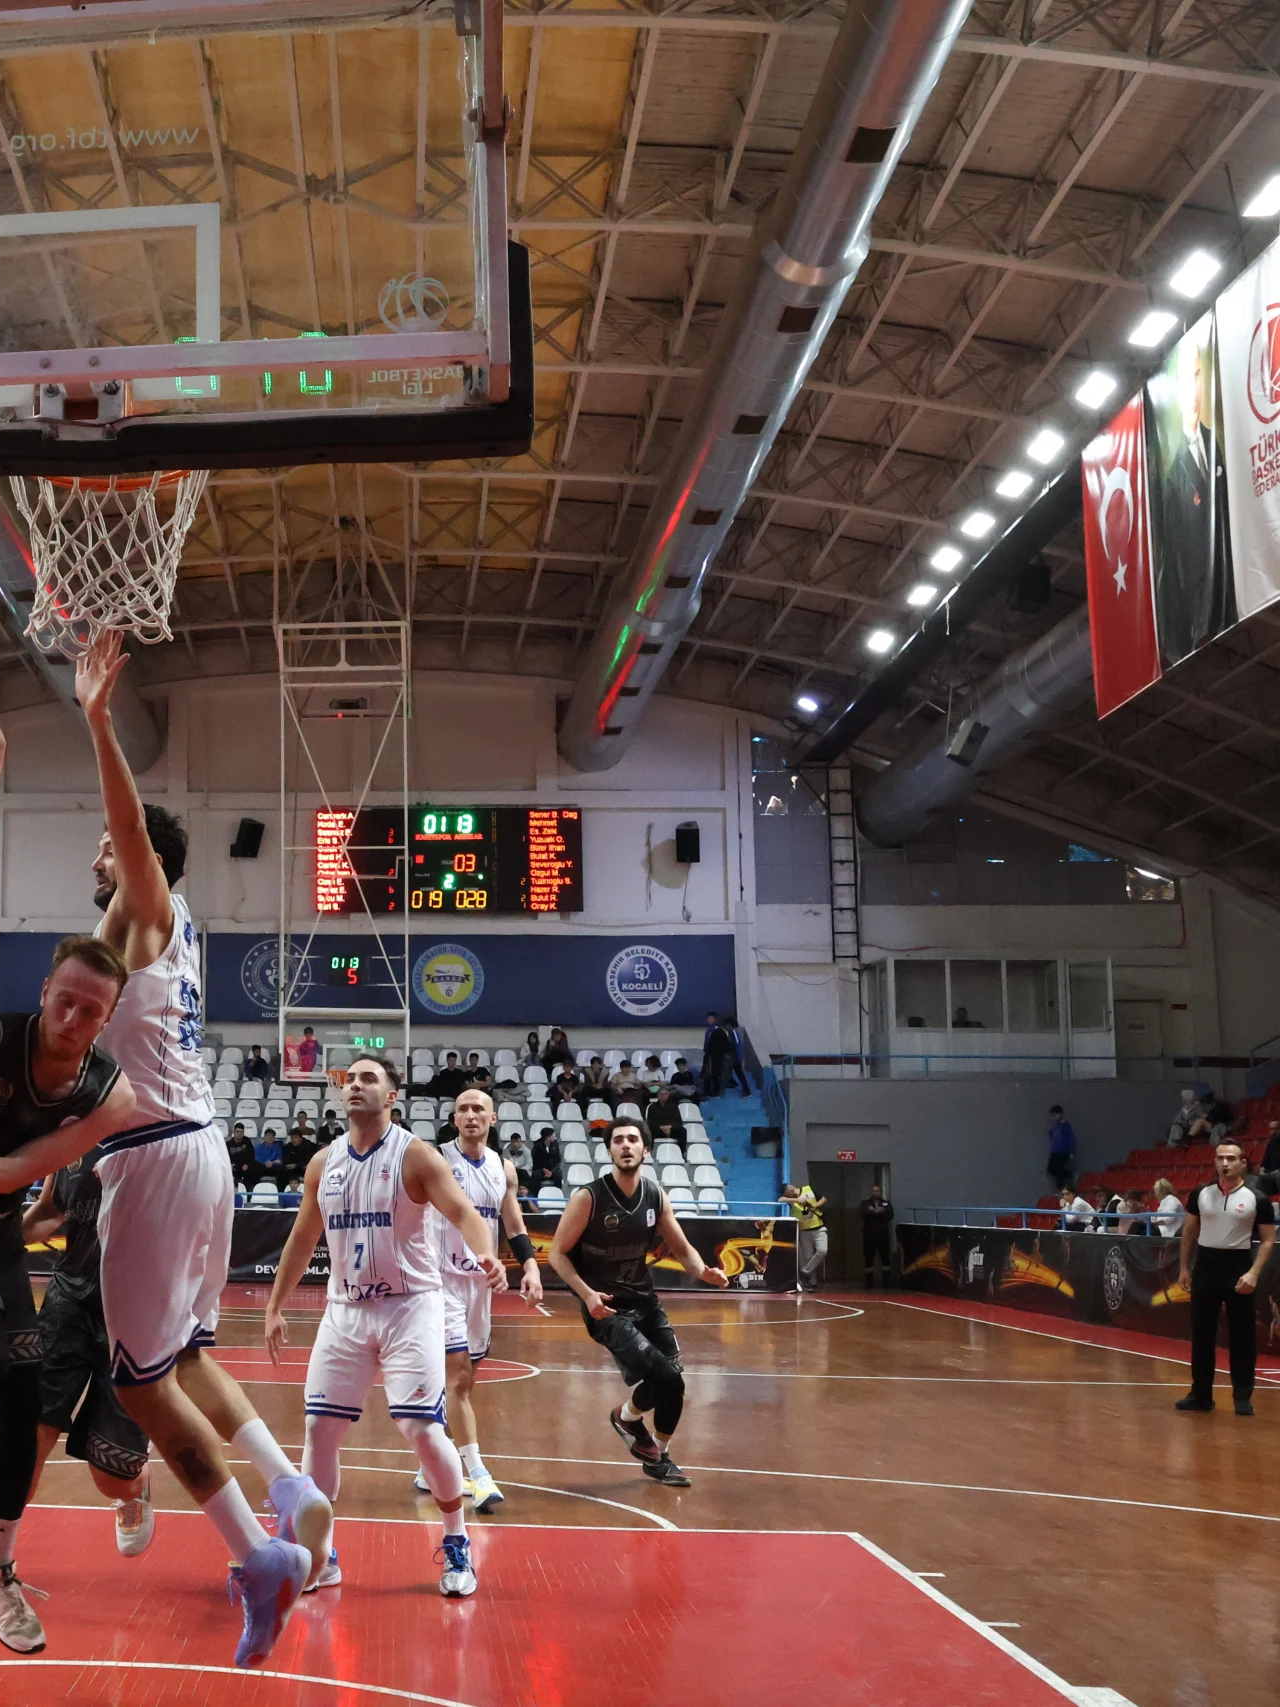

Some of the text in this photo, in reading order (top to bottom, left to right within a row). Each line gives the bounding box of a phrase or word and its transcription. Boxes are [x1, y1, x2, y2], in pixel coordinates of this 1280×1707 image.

[529, 819, 558, 827] Mehmet
[454, 854, 476, 872] 03
[443, 873, 455, 889] 2
[455, 890, 487, 908] 028
[347, 968, 358, 985] 5
[622, 981, 663, 991] KOCAELİ
[354, 1243, 364, 1270] 7
